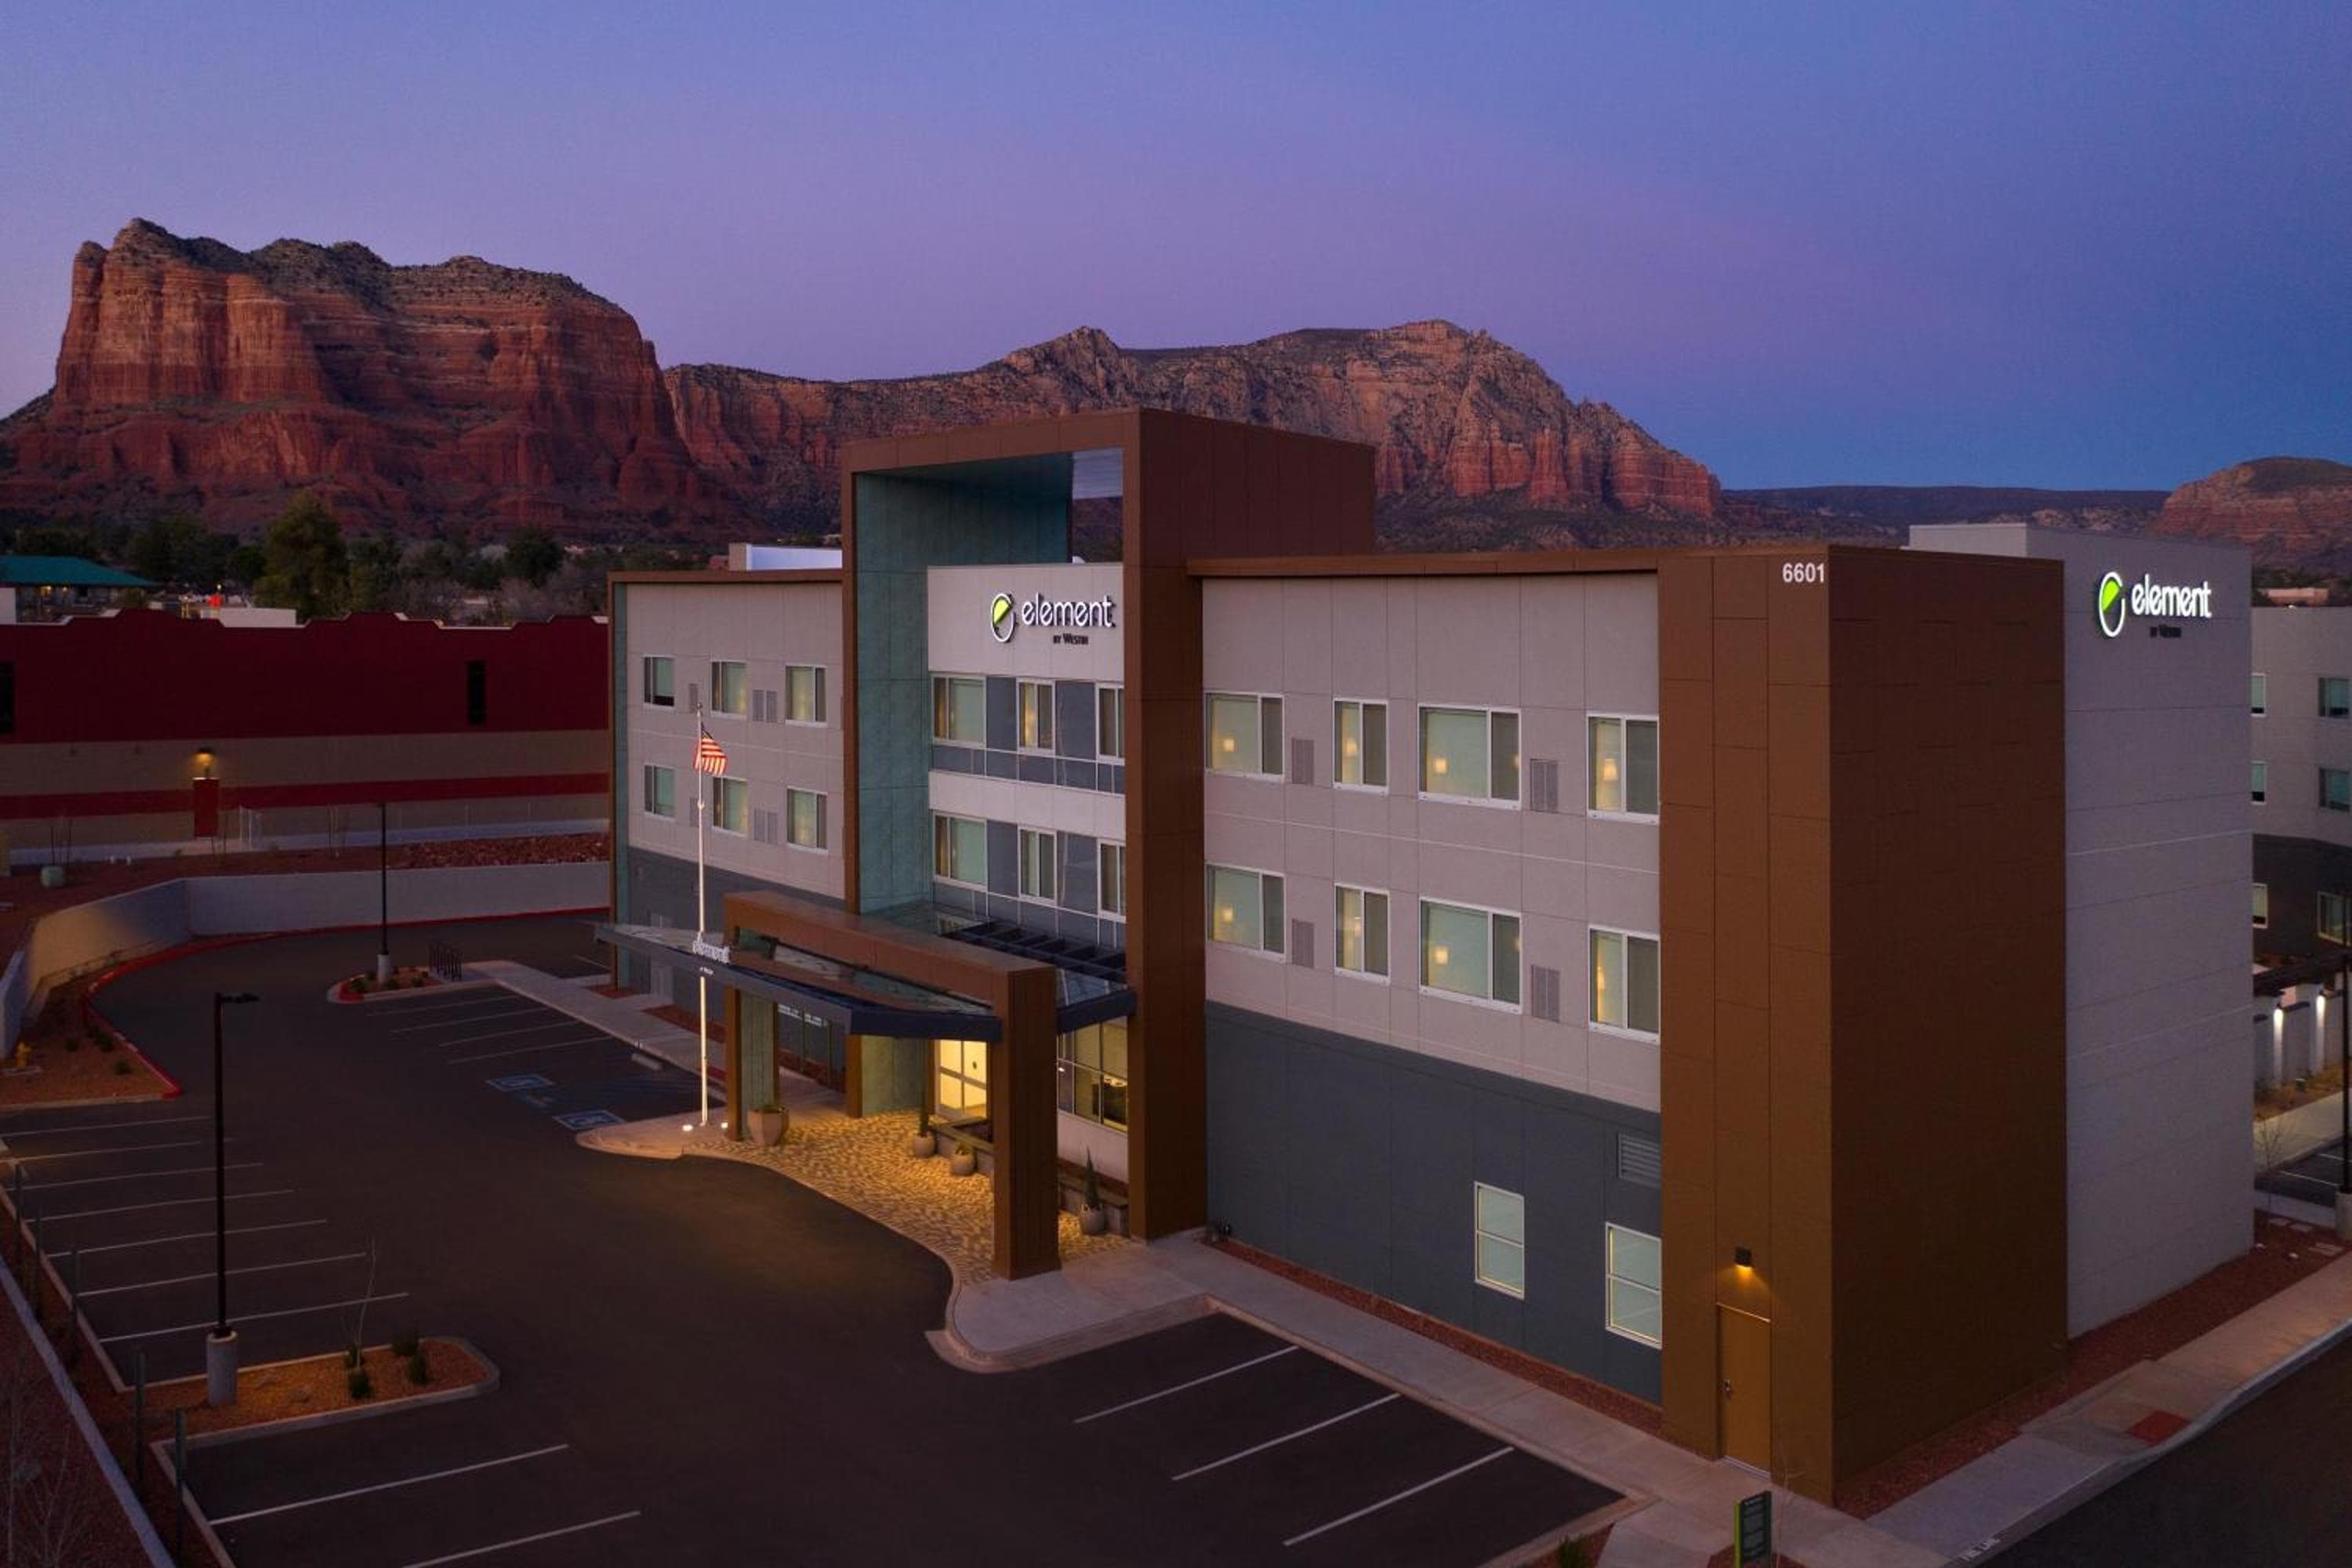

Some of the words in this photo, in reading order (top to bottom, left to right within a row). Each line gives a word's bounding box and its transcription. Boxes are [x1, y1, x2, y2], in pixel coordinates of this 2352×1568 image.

[1782, 562, 1825, 583] 6601
[1022, 592, 1112, 628] element
[2131, 573, 2212, 619] element
